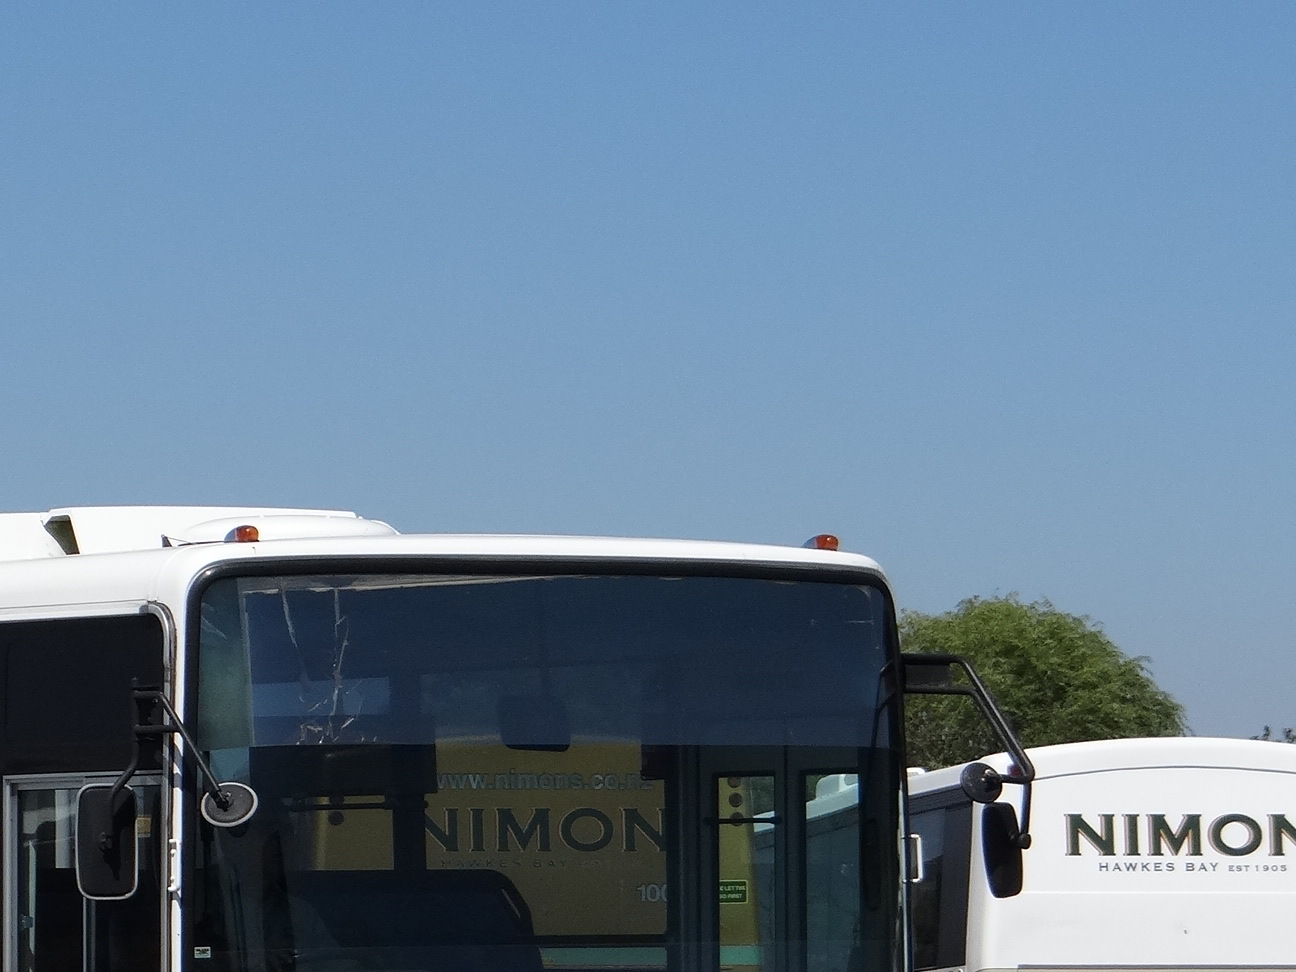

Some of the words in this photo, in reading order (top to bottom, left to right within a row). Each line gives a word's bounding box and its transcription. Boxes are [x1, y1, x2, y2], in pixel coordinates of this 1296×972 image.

[1064, 813, 1296, 856] NIMON
[441, 858, 522, 869] HAWKES
[533, 858, 567, 869] BAY
[1098, 862, 1175, 872] HAWKES
[1185, 862, 1219, 872] BAY
[1228, 864, 1250, 872] EST
[1255, 864, 1287, 872] 1905
